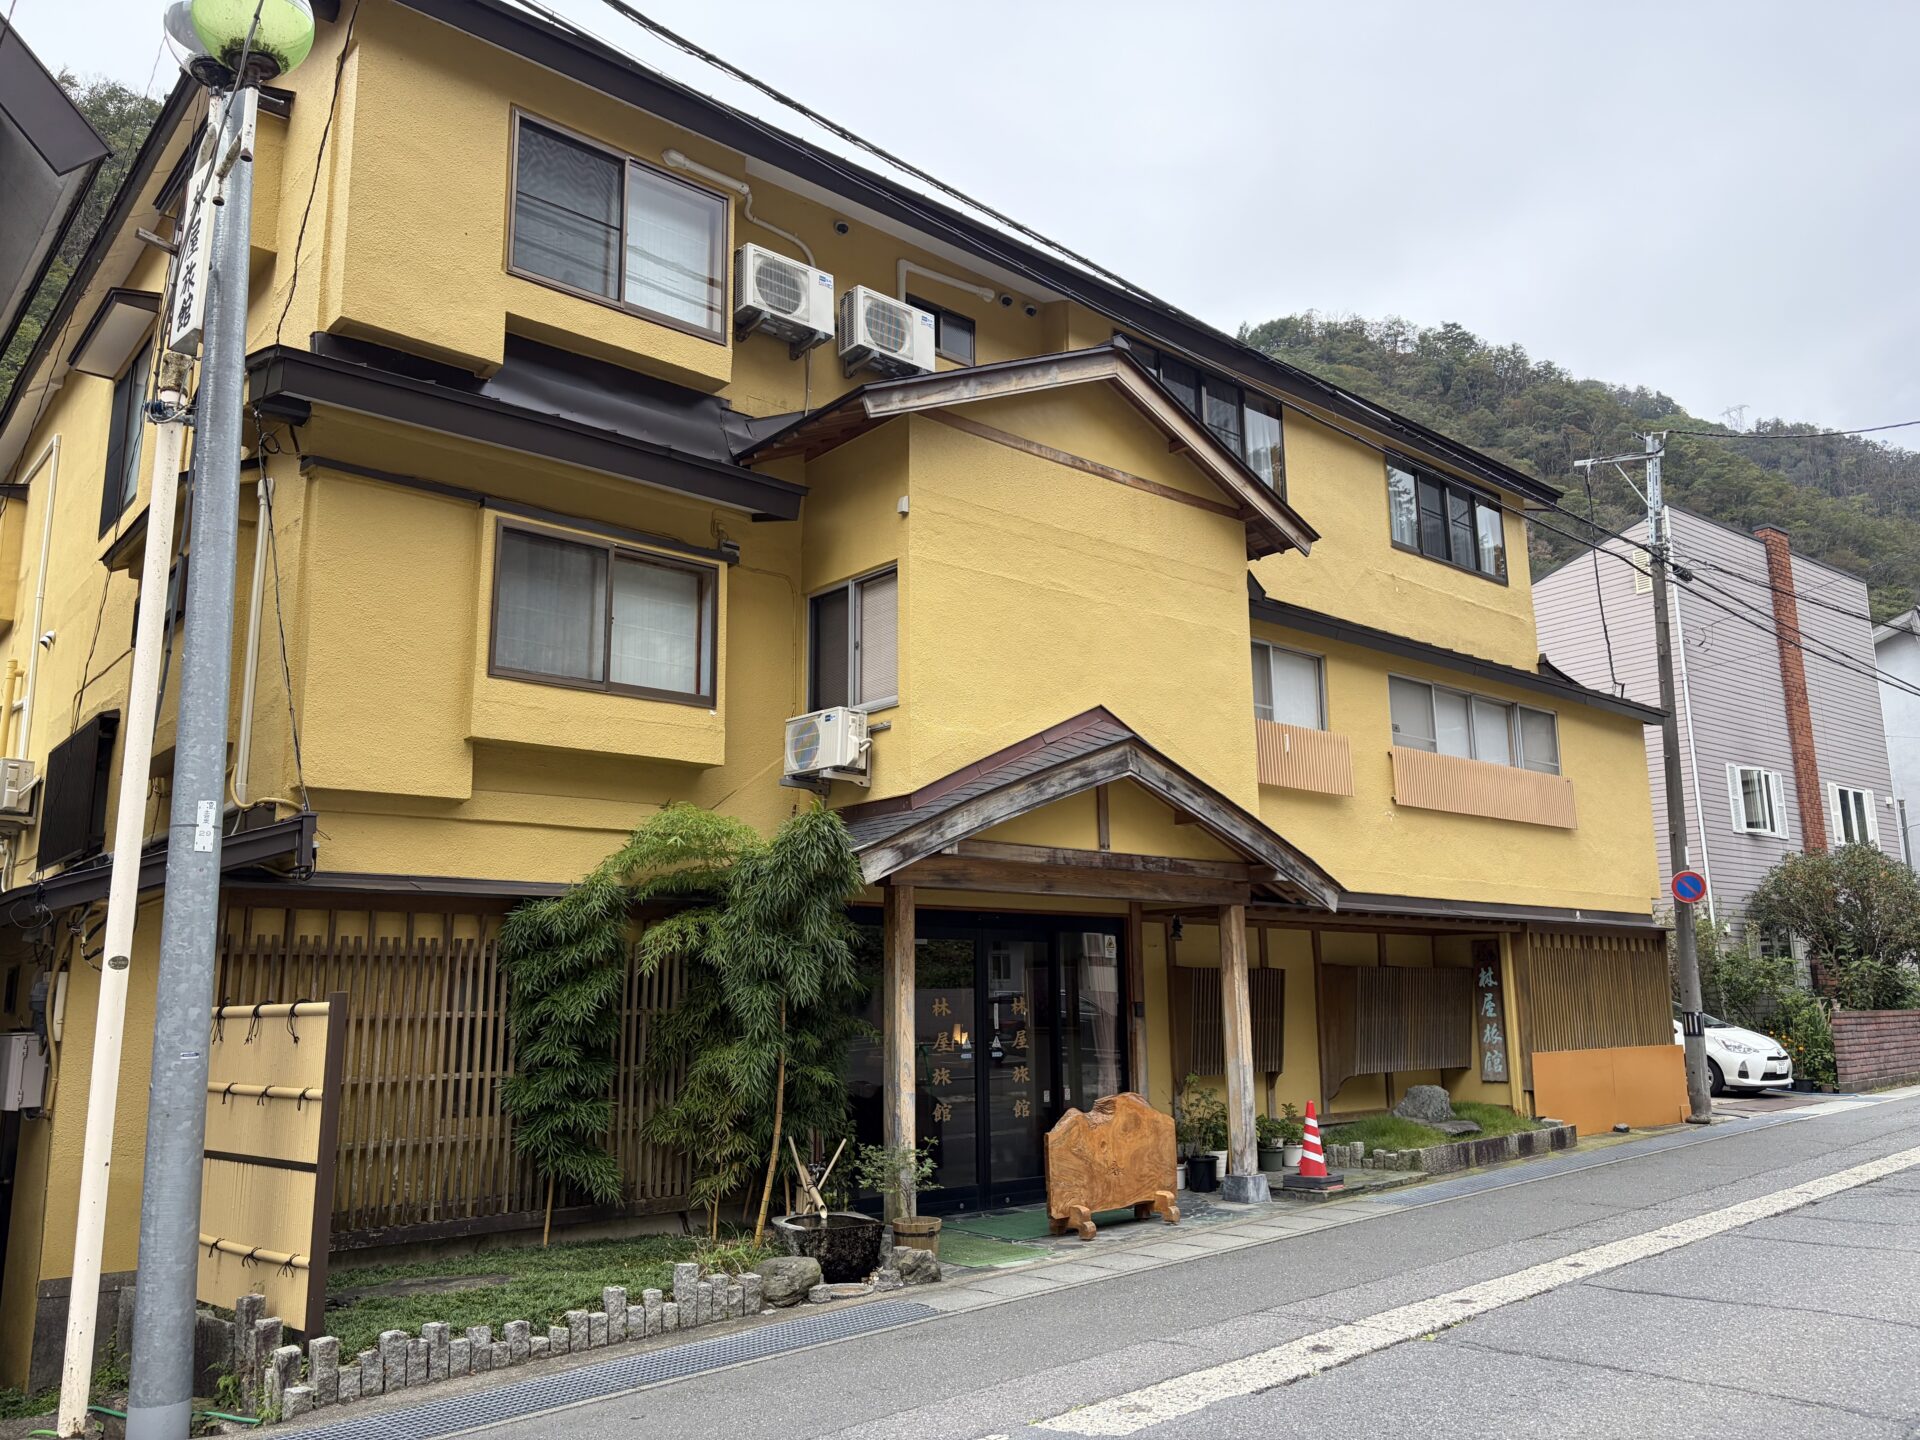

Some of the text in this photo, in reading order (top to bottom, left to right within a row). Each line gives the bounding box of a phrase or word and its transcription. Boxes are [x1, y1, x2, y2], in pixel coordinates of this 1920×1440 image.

[932, 997, 952, 1122] 林屋旅館
[1011, 997, 1030, 1119] 林屋旅館
[1478, 967, 1504, 1073] 林屋旅館
